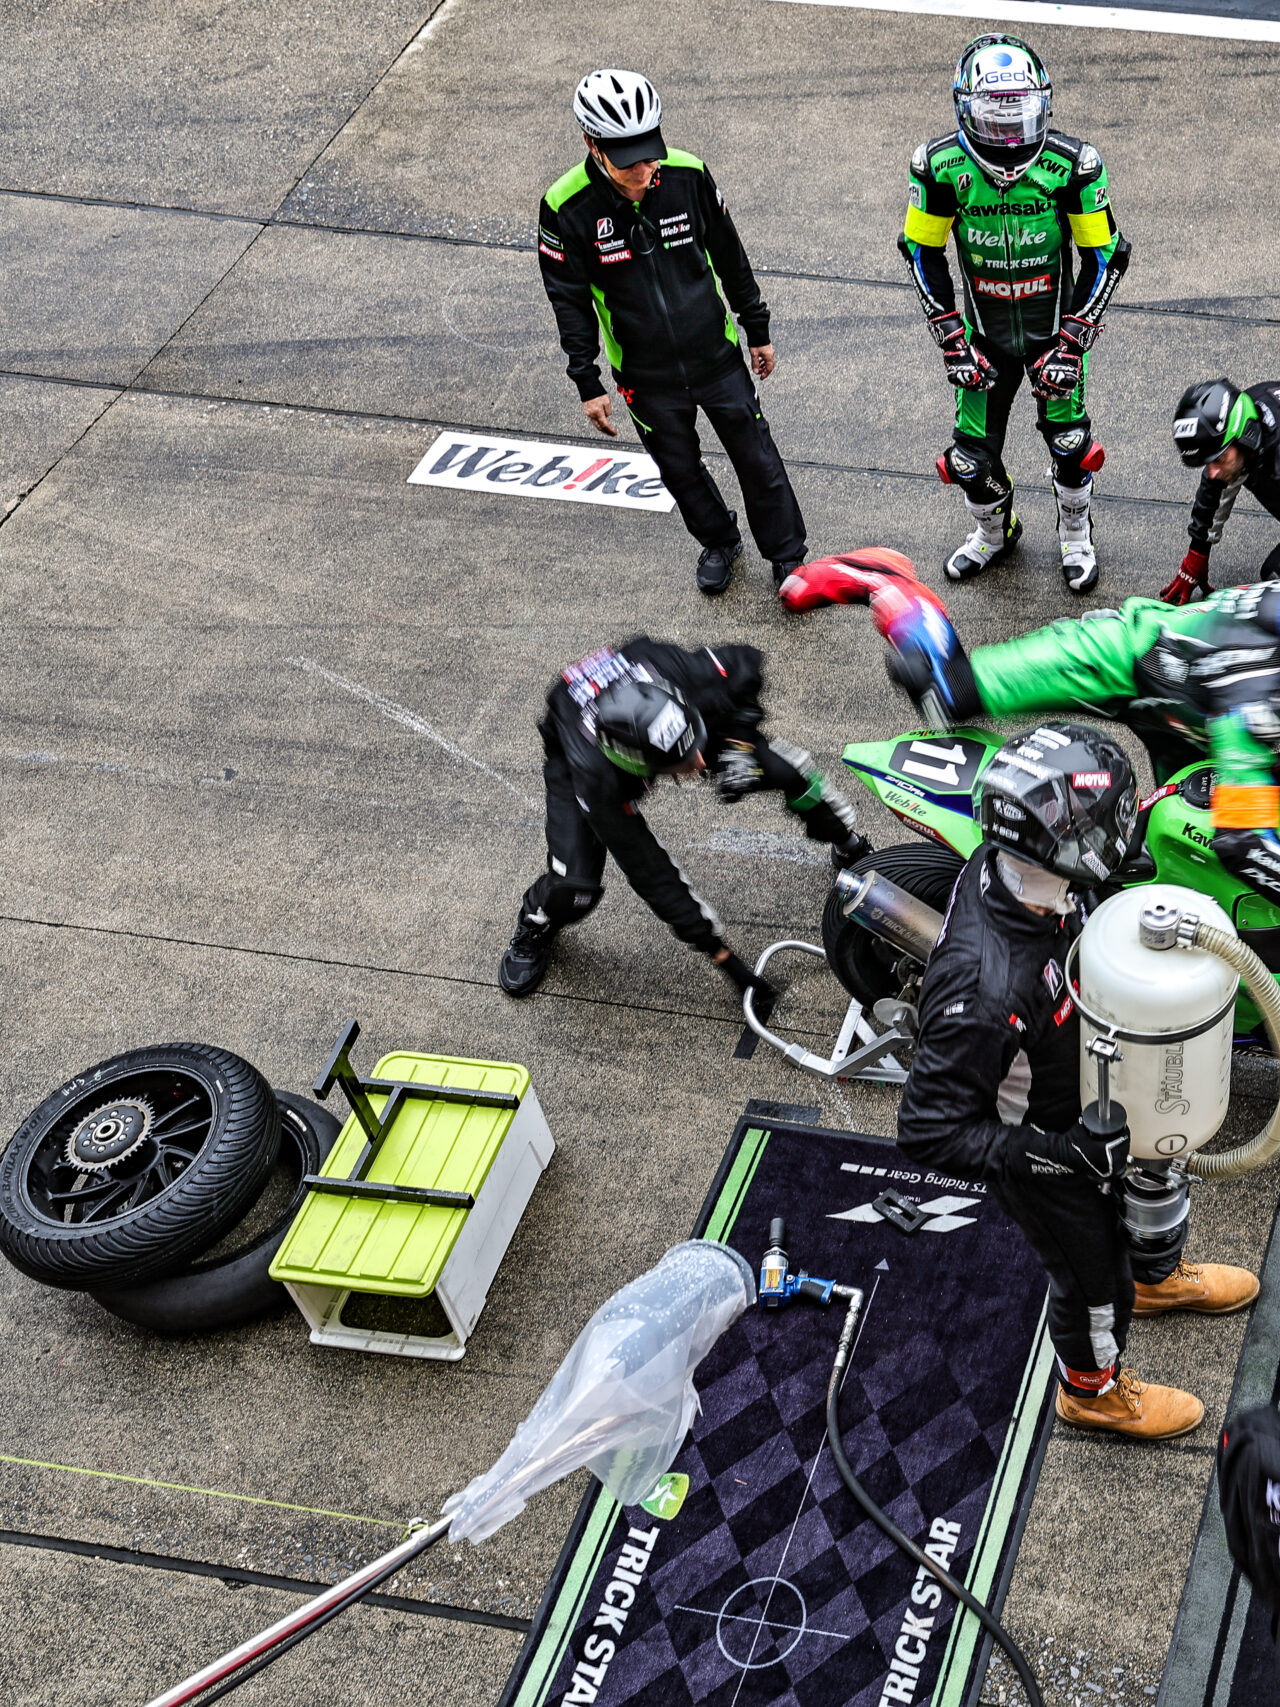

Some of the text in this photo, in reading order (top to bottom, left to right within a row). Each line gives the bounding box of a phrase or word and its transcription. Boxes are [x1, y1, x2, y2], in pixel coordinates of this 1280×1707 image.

[985, 70, 1026, 85] Ged
[934, 155, 967, 174] NOLAN
[1035, 156, 1071, 178] KWT
[956, 201, 1052, 217] Kawasaki
[659, 212, 689, 226] Kawasaki
[540, 245, 563, 260] MOTUL
[601, 251, 631, 263] MOTUL
[985, 254, 1049, 269] TRICK STAR
[978, 278, 1049, 298] MOTUL
[1085, 267, 1120, 323] Kawasaki
[902, 740, 967, 786] 11
[1074, 773, 1111, 788] MOTUL
[903, 816, 937, 837] MOTUL
[881, 915, 907, 934] TRICK
[837, 1075, 906, 1089] MOTO-TRO
[1155, 1042, 1191, 1115] STÄUBL
[2, 1143, 23, 1193] BATTLAX
[887, 1169, 988, 1194] TS Riding Gear
[592, 1526, 660, 1636] TRICK
[878, 1516, 962, 1707] TRICK STAR
